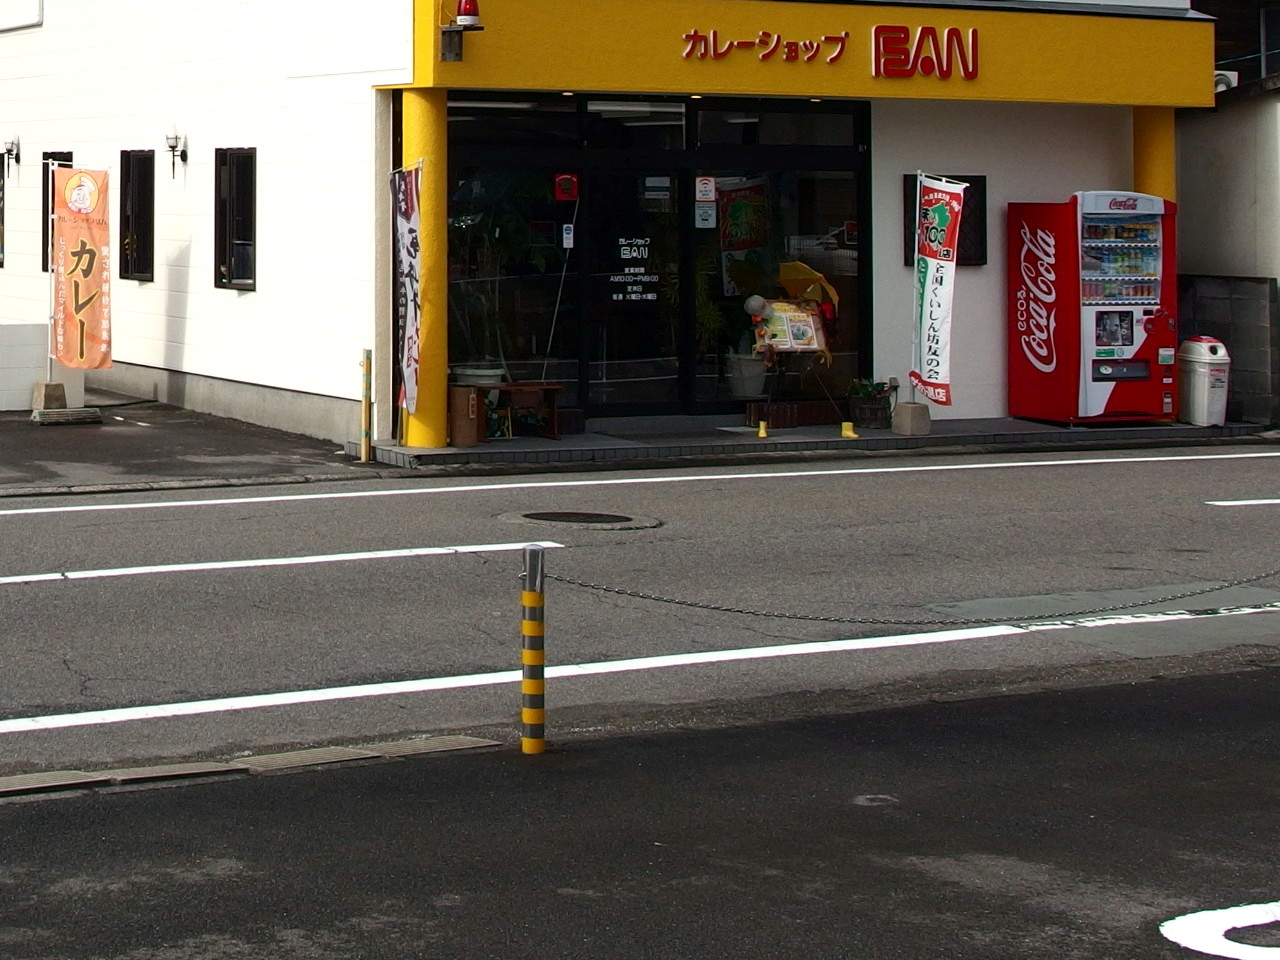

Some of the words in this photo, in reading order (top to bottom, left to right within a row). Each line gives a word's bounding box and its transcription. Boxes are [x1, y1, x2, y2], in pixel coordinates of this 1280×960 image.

[681, 28, 850, 64] カレーショップ
[871, 23, 979, 80] BAN
[1109, 197, 1138, 210] Coca-Cola
[66, 239, 101, 361] カレー
[1020, 219, 1057, 373] Coca-Cola
